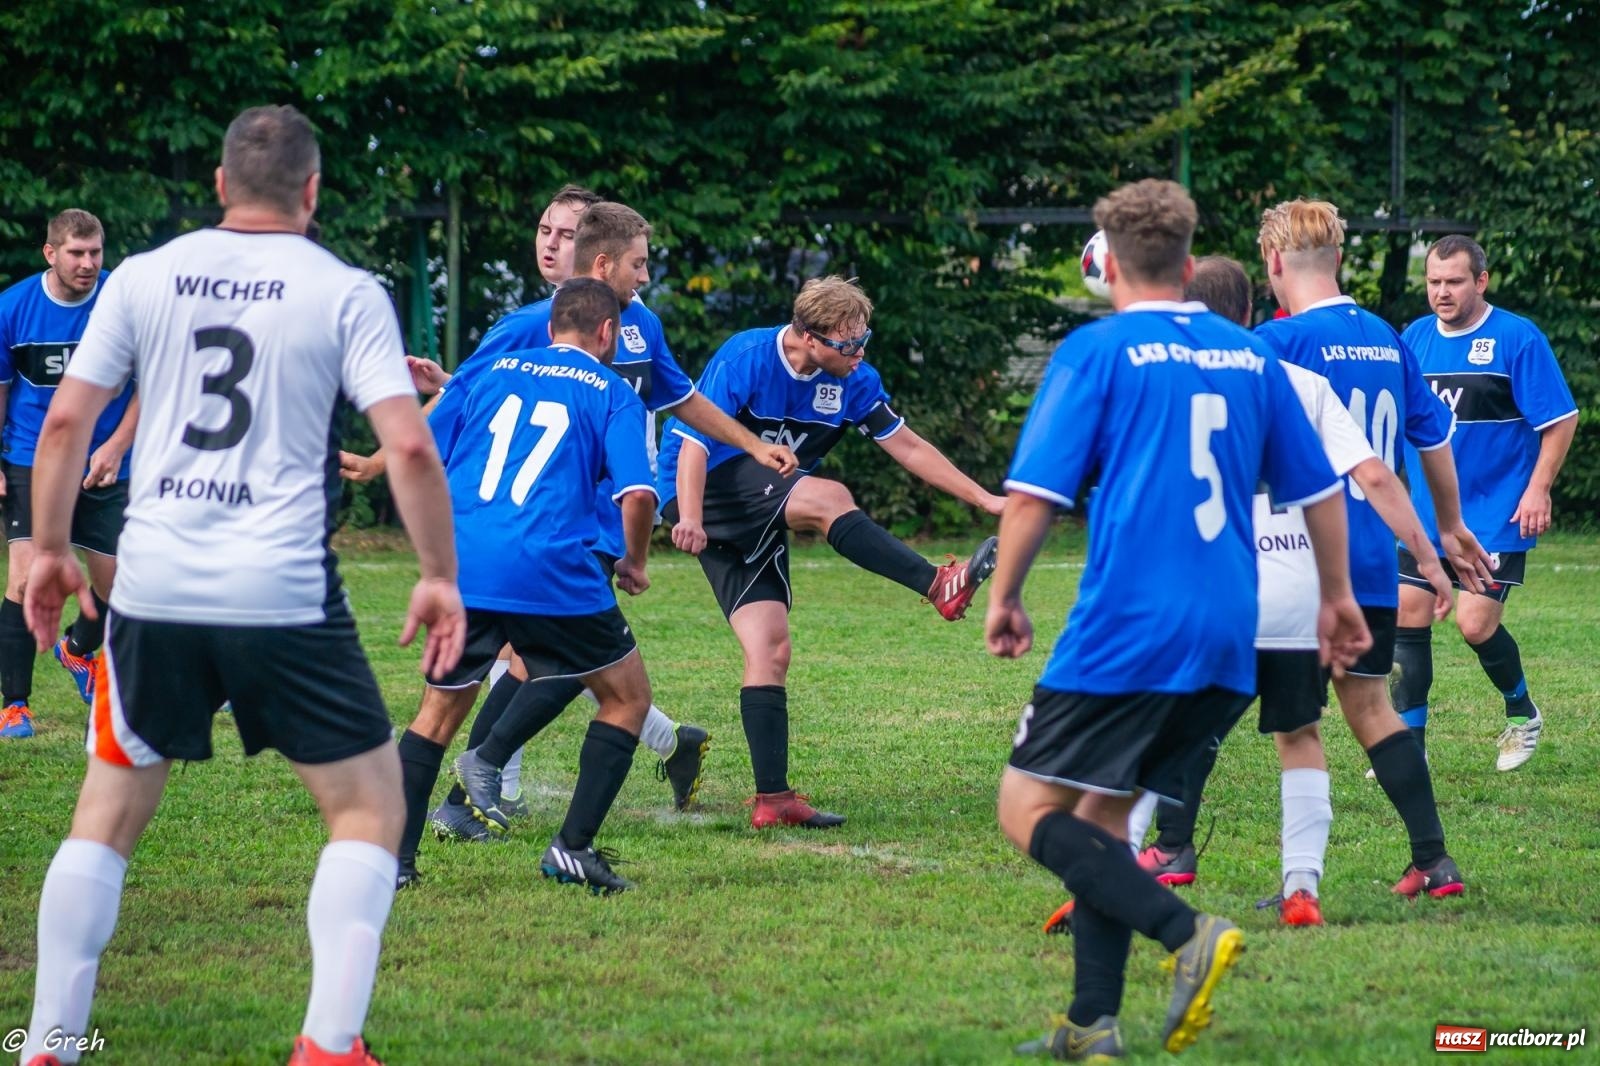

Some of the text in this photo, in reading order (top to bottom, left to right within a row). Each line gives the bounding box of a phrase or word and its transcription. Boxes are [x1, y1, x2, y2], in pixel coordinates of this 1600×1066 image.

[175, 275, 285, 301] WICHER
[624, 328, 639, 341] 95
[1475, 341, 1490, 353] 95
[1126, 342, 1169, 367] LKS
[1321, 345, 1347, 362] LKS
[182, 325, 255, 451] 3
[520, 362, 609, 392] CYPRZANÓW
[819, 387, 837, 401] 95
[478, 392, 570, 507] 17
[1348, 387, 1398, 501] 10
[1190, 392, 1228, 543] 5
[159, 476, 254, 506] PŁONIA
[1255, 533, 1311, 553] ONIA
